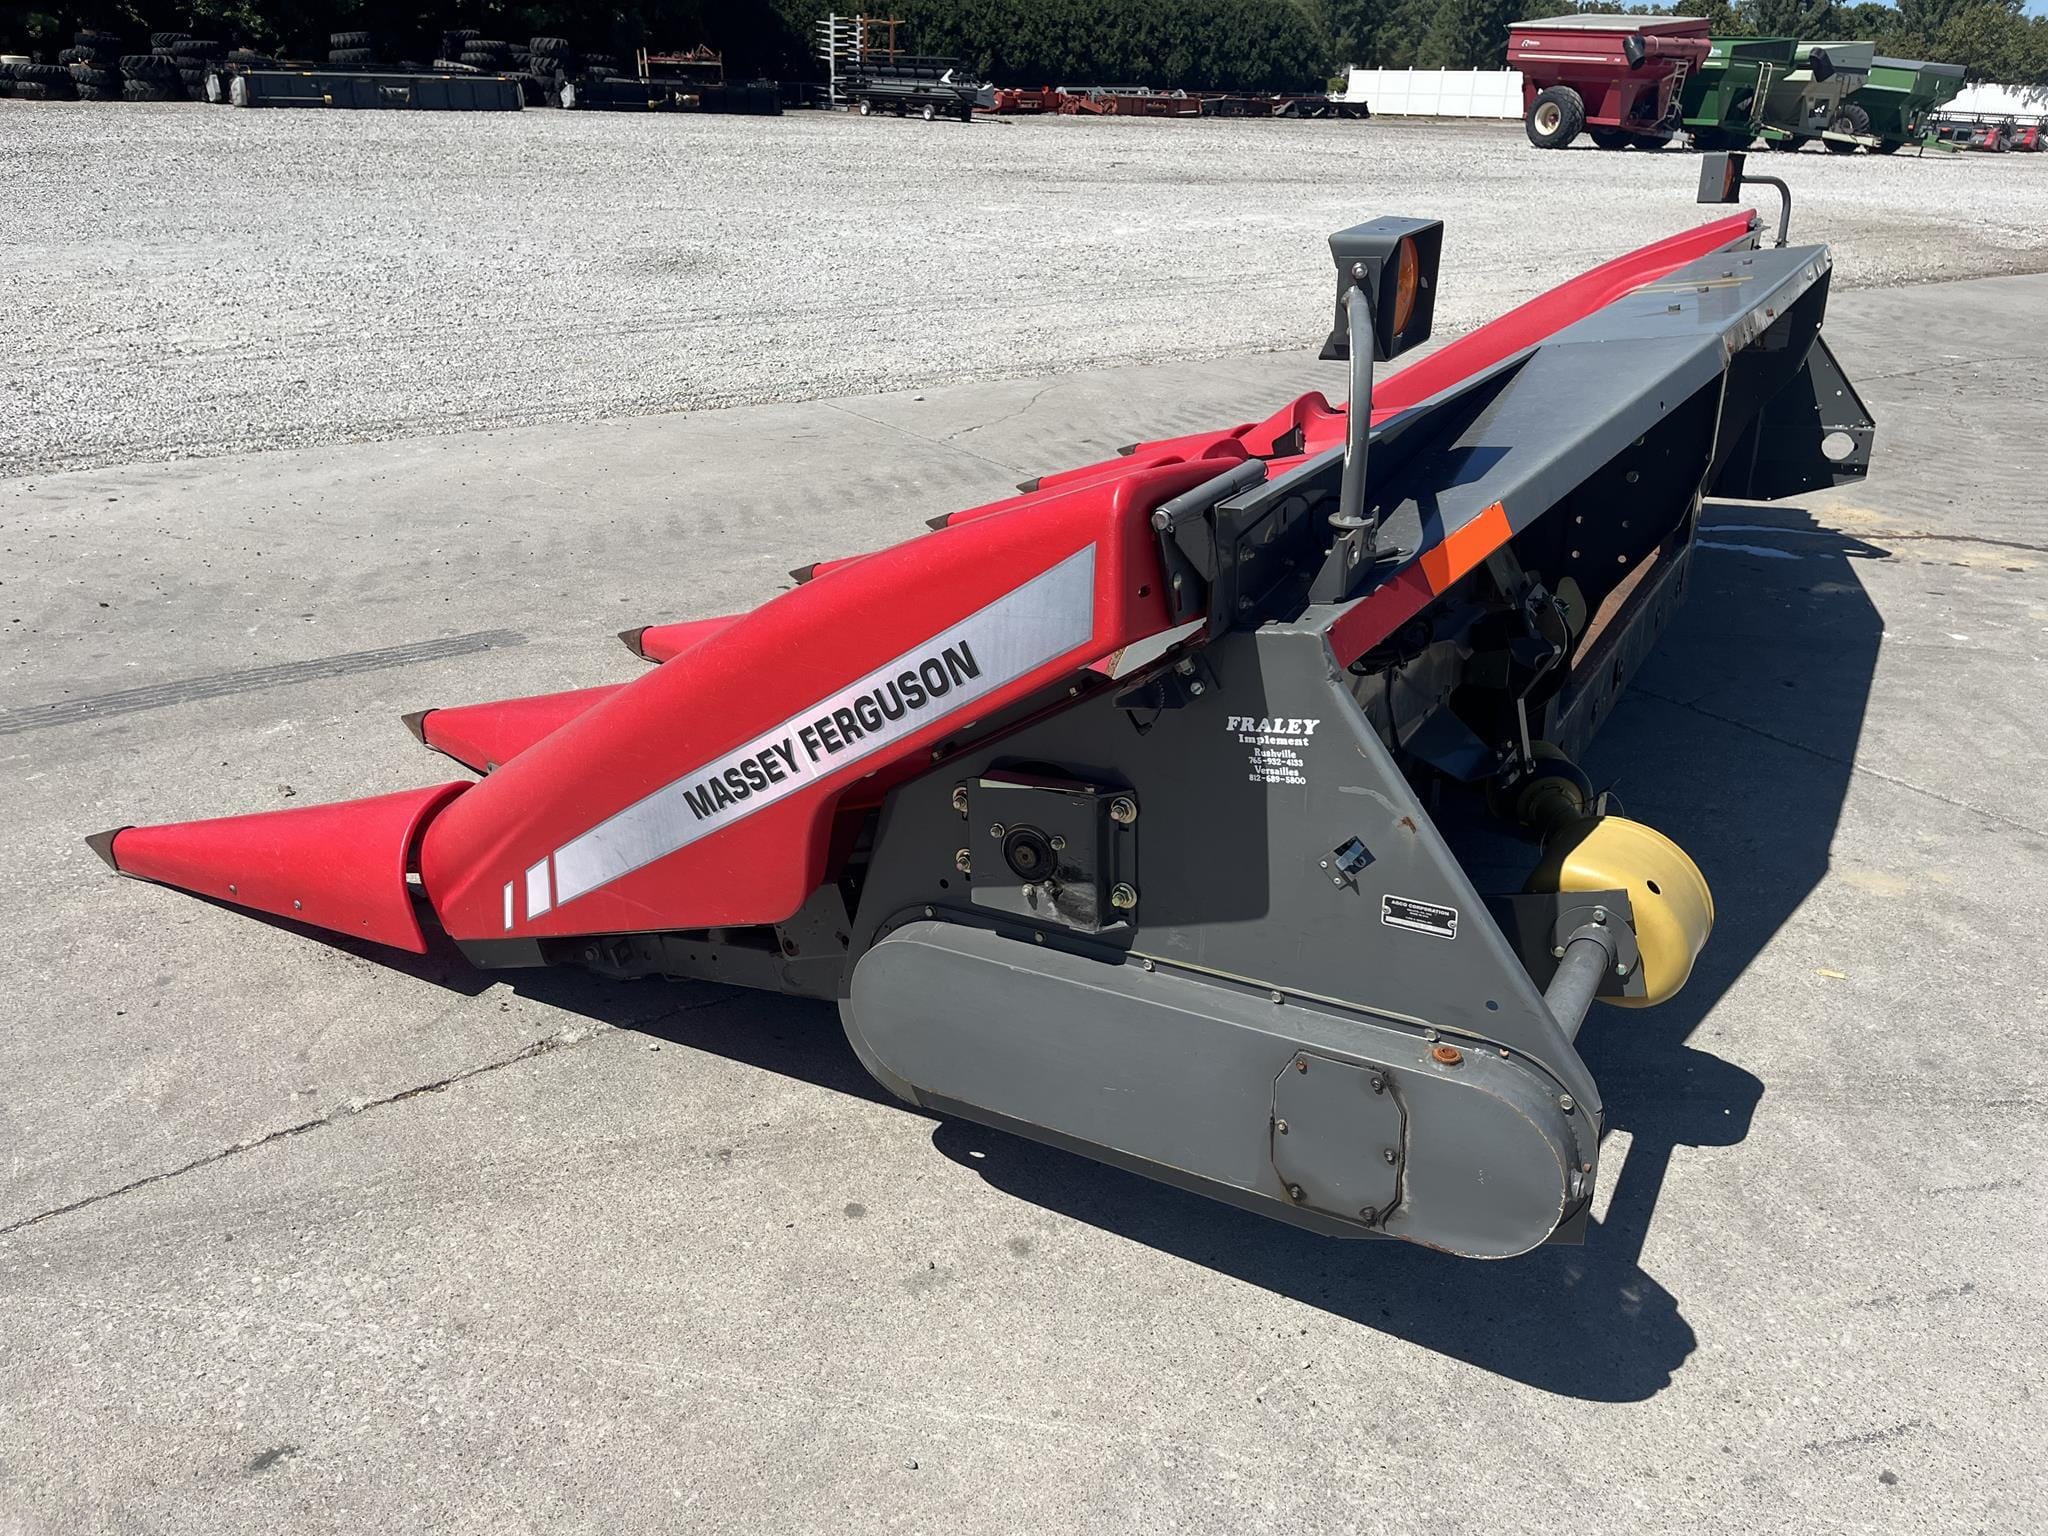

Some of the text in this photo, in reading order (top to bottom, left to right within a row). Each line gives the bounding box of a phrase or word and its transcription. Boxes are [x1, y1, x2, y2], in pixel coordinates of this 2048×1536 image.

[683, 640, 981, 820] MASSEY FERGUSON
[1226, 716, 1320, 734] FRALEY
[1238, 734, 1309, 746] Implement
[1254, 748, 1297, 758] Rushville
[1254, 765, 1299, 776] Versailles
[1408, 903, 1450, 916] CORPORATION
